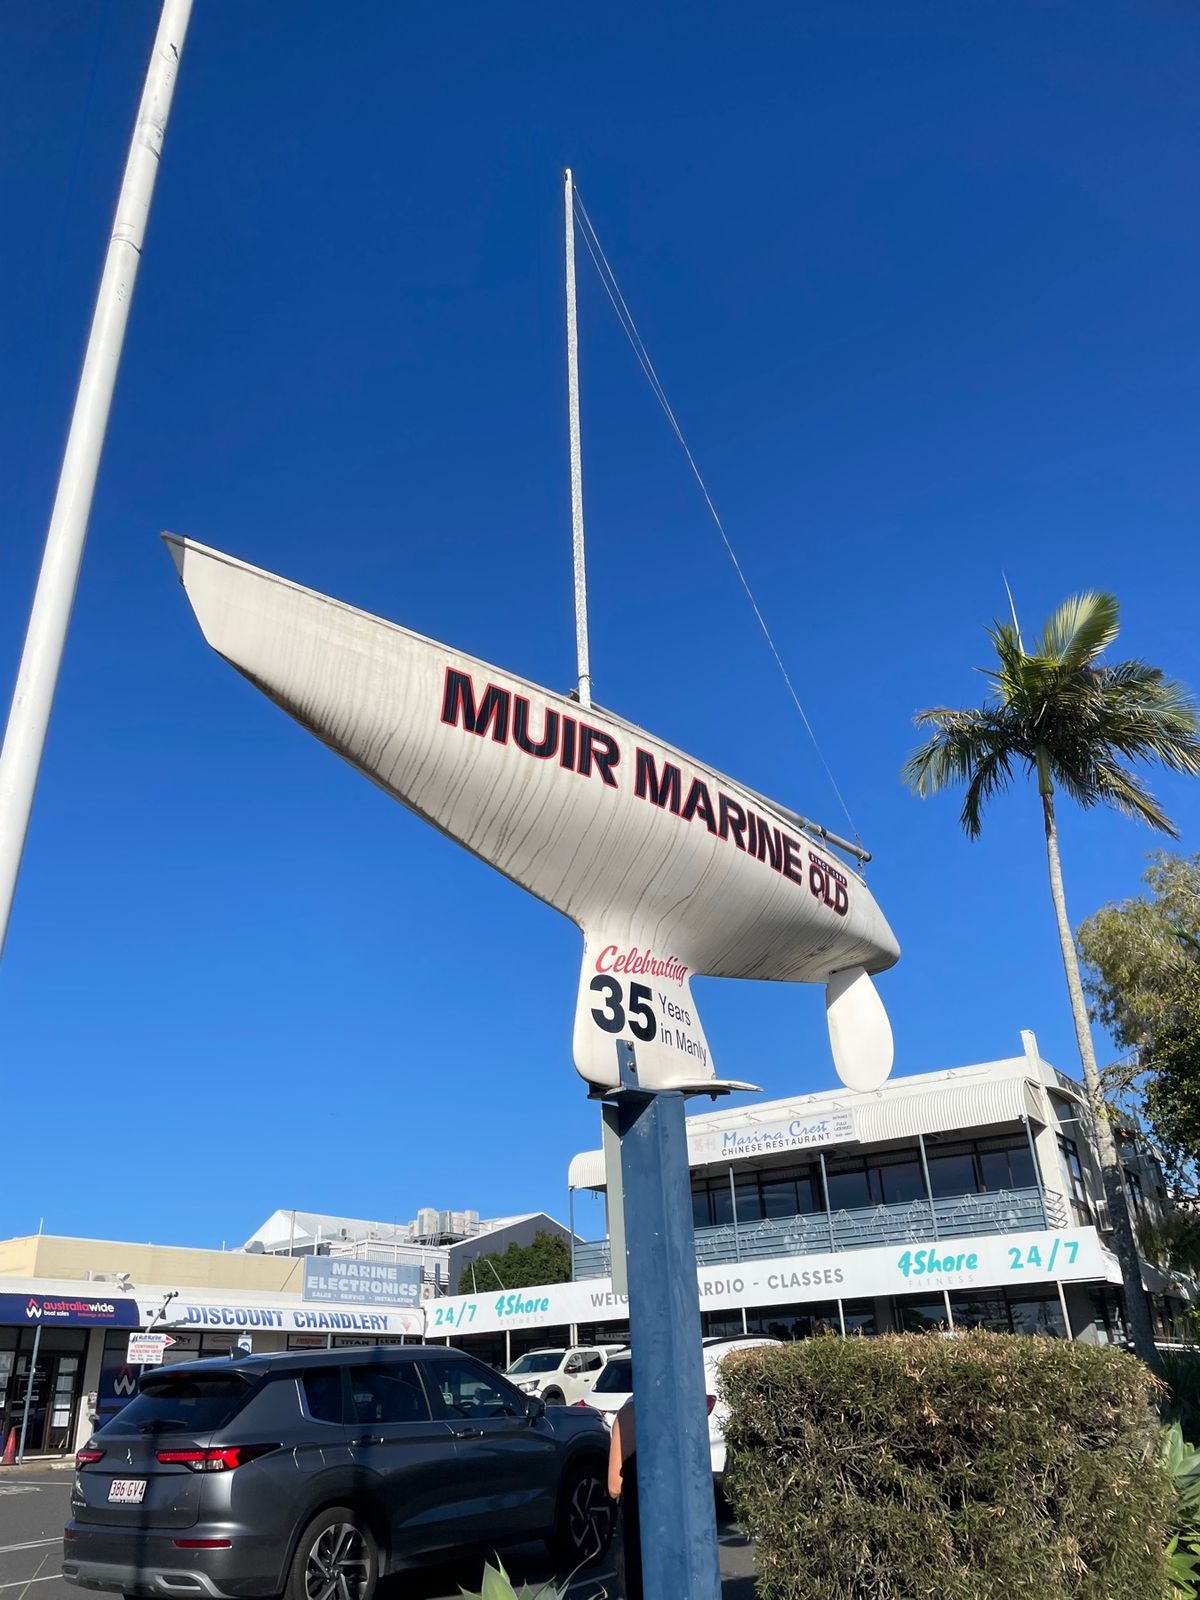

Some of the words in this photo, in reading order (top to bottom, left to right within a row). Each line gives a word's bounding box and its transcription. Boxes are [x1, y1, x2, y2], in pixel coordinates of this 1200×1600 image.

[441, 666, 620, 788] MUIR
[634, 746, 802, 886] MARINE
[809, 862, 849, 917] QLD
[595, 945, 688, 987] Celebrating
[589, 974, 657, 1042] 35
[658, 993, 691, 1026] Years
[660, 1023, 672, 1044] in
[676, 1030, 708, 1067] Manly
[721, 1143, 763, 1157] CHINESE
[766, 1132, 831, 1150] RESTAURANT
[722, 1131, 783, 1148] Marina
[789, 1120, 830, 1137] Crest
[332, 1262, 398, 1280] MARINE
[897, 1250, 978, 1278] 4Shore
[1008, 1238, 1079, 1272] 24/7
[307, 1276, 418, 1296] ELECTRONICS
[767, 1267, 844, 1290] CLASSES
[908, 1275, 975, 1289] FITNESS
[43, 1301, 115, 1312] australiawide
[186, 1306, 283, 1327] DISCOUNT
[294, 1311, 389, 1330] CHANDLERY
[434, 1301, 477, 1328] 24/7
[495, 1294, 549, 1317] 4Shore
